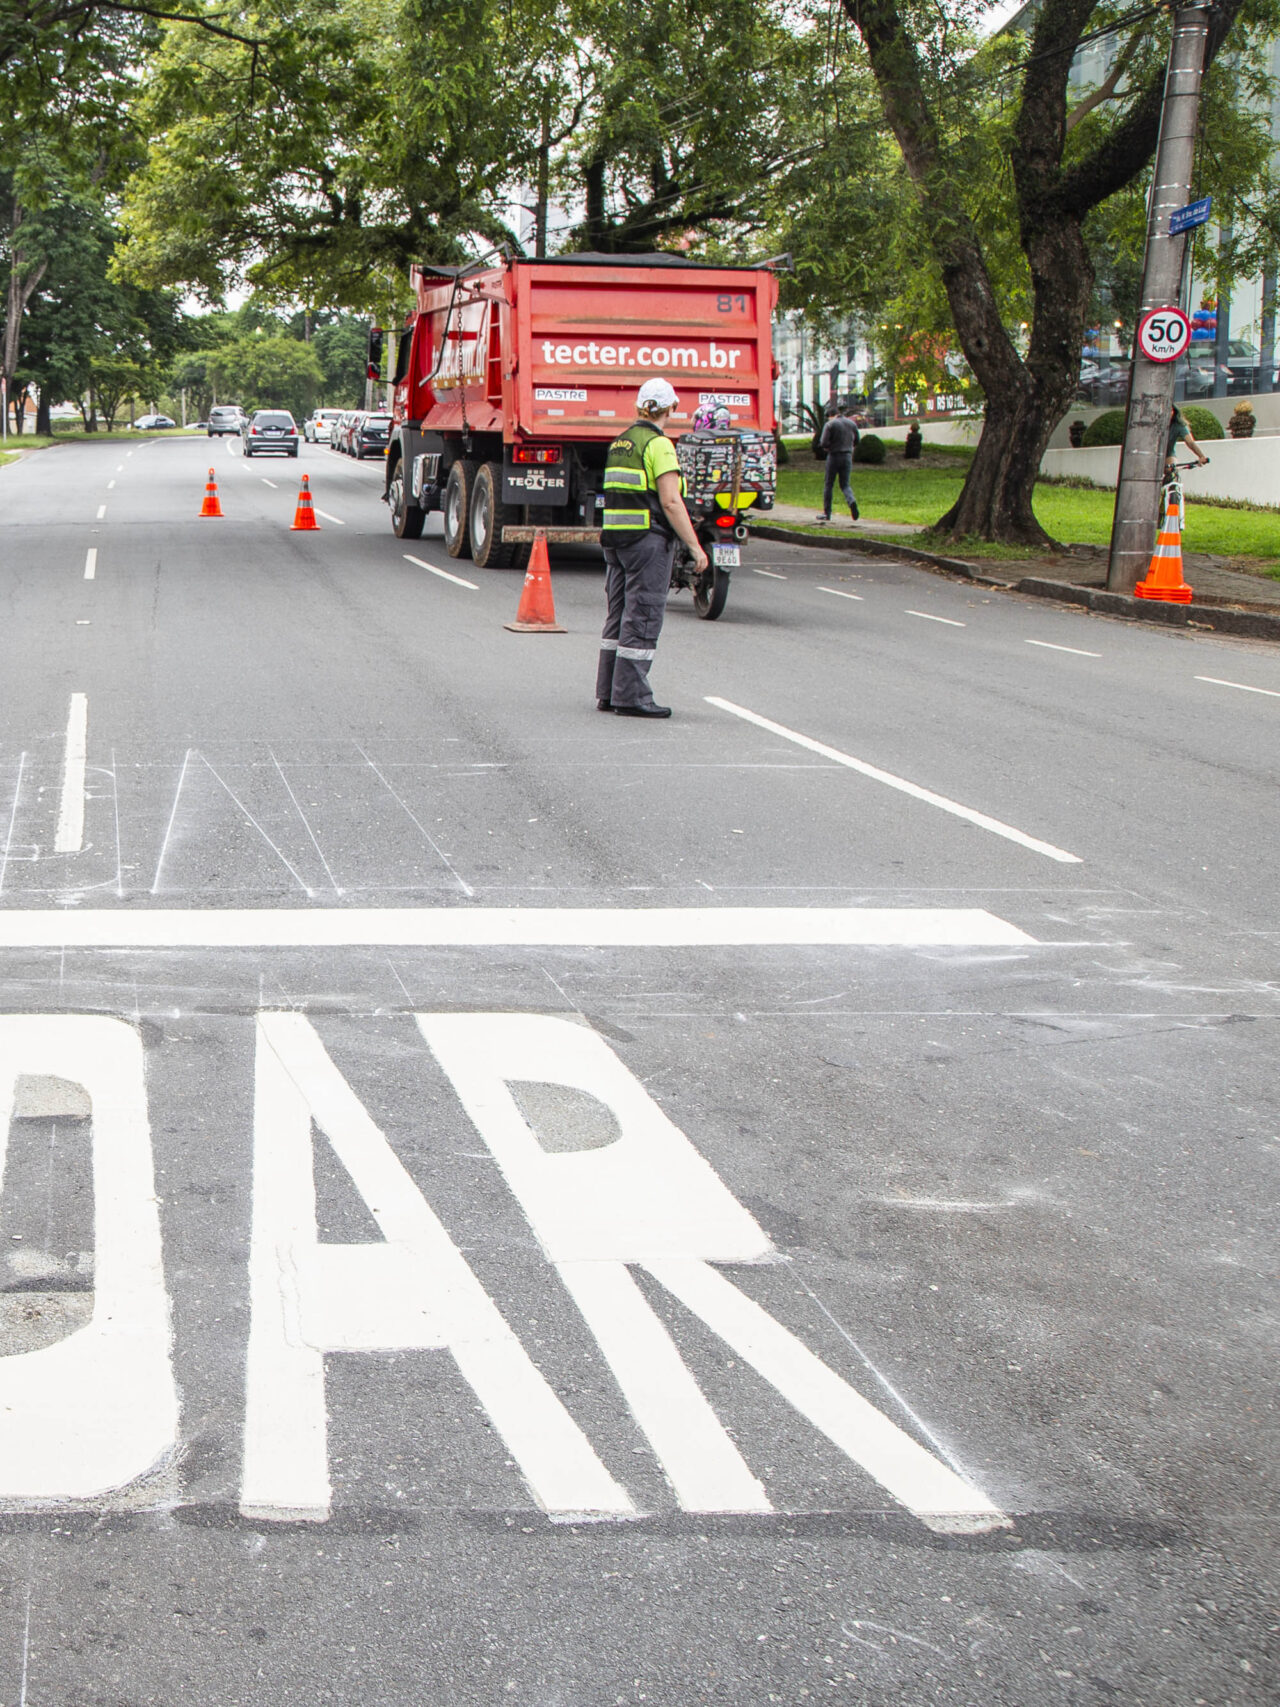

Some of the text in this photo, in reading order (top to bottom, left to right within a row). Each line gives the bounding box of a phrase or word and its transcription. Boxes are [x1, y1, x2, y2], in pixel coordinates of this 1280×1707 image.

[717, 294, 746, 313] 81
[1148, 319, 1184, 343] 50
[542, 341, 741, 369] tecter.com.br
[536, 389, 586, 401] PASTRE
[700, 394, 749, 405] PASTRE
[507, 477, 565, 488] TECTER
